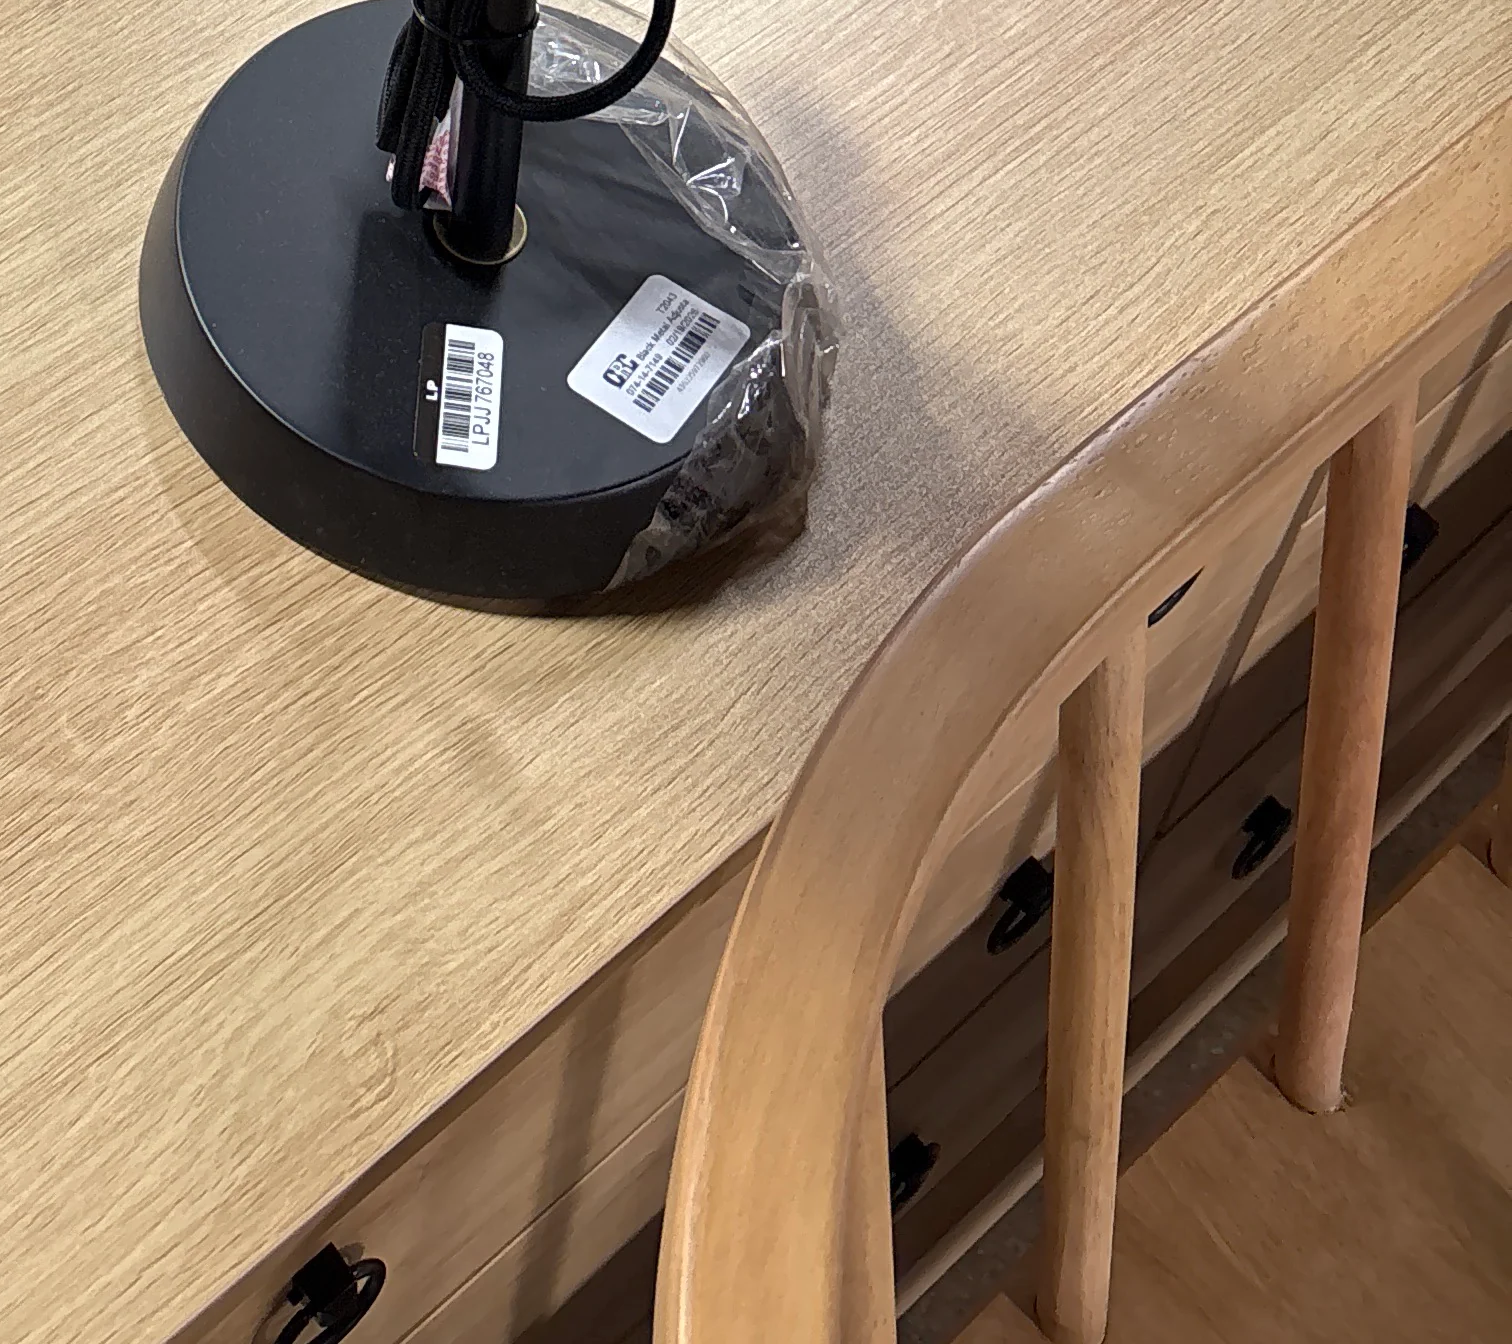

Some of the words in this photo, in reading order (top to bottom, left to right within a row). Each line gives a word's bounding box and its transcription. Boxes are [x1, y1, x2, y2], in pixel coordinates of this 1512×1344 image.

[636, 341, 656, 361] Black
[651, 321, 670, 342] Metal
[666, 299, 689, 323] Adjusta
[426, 379, 438, 401] LP
